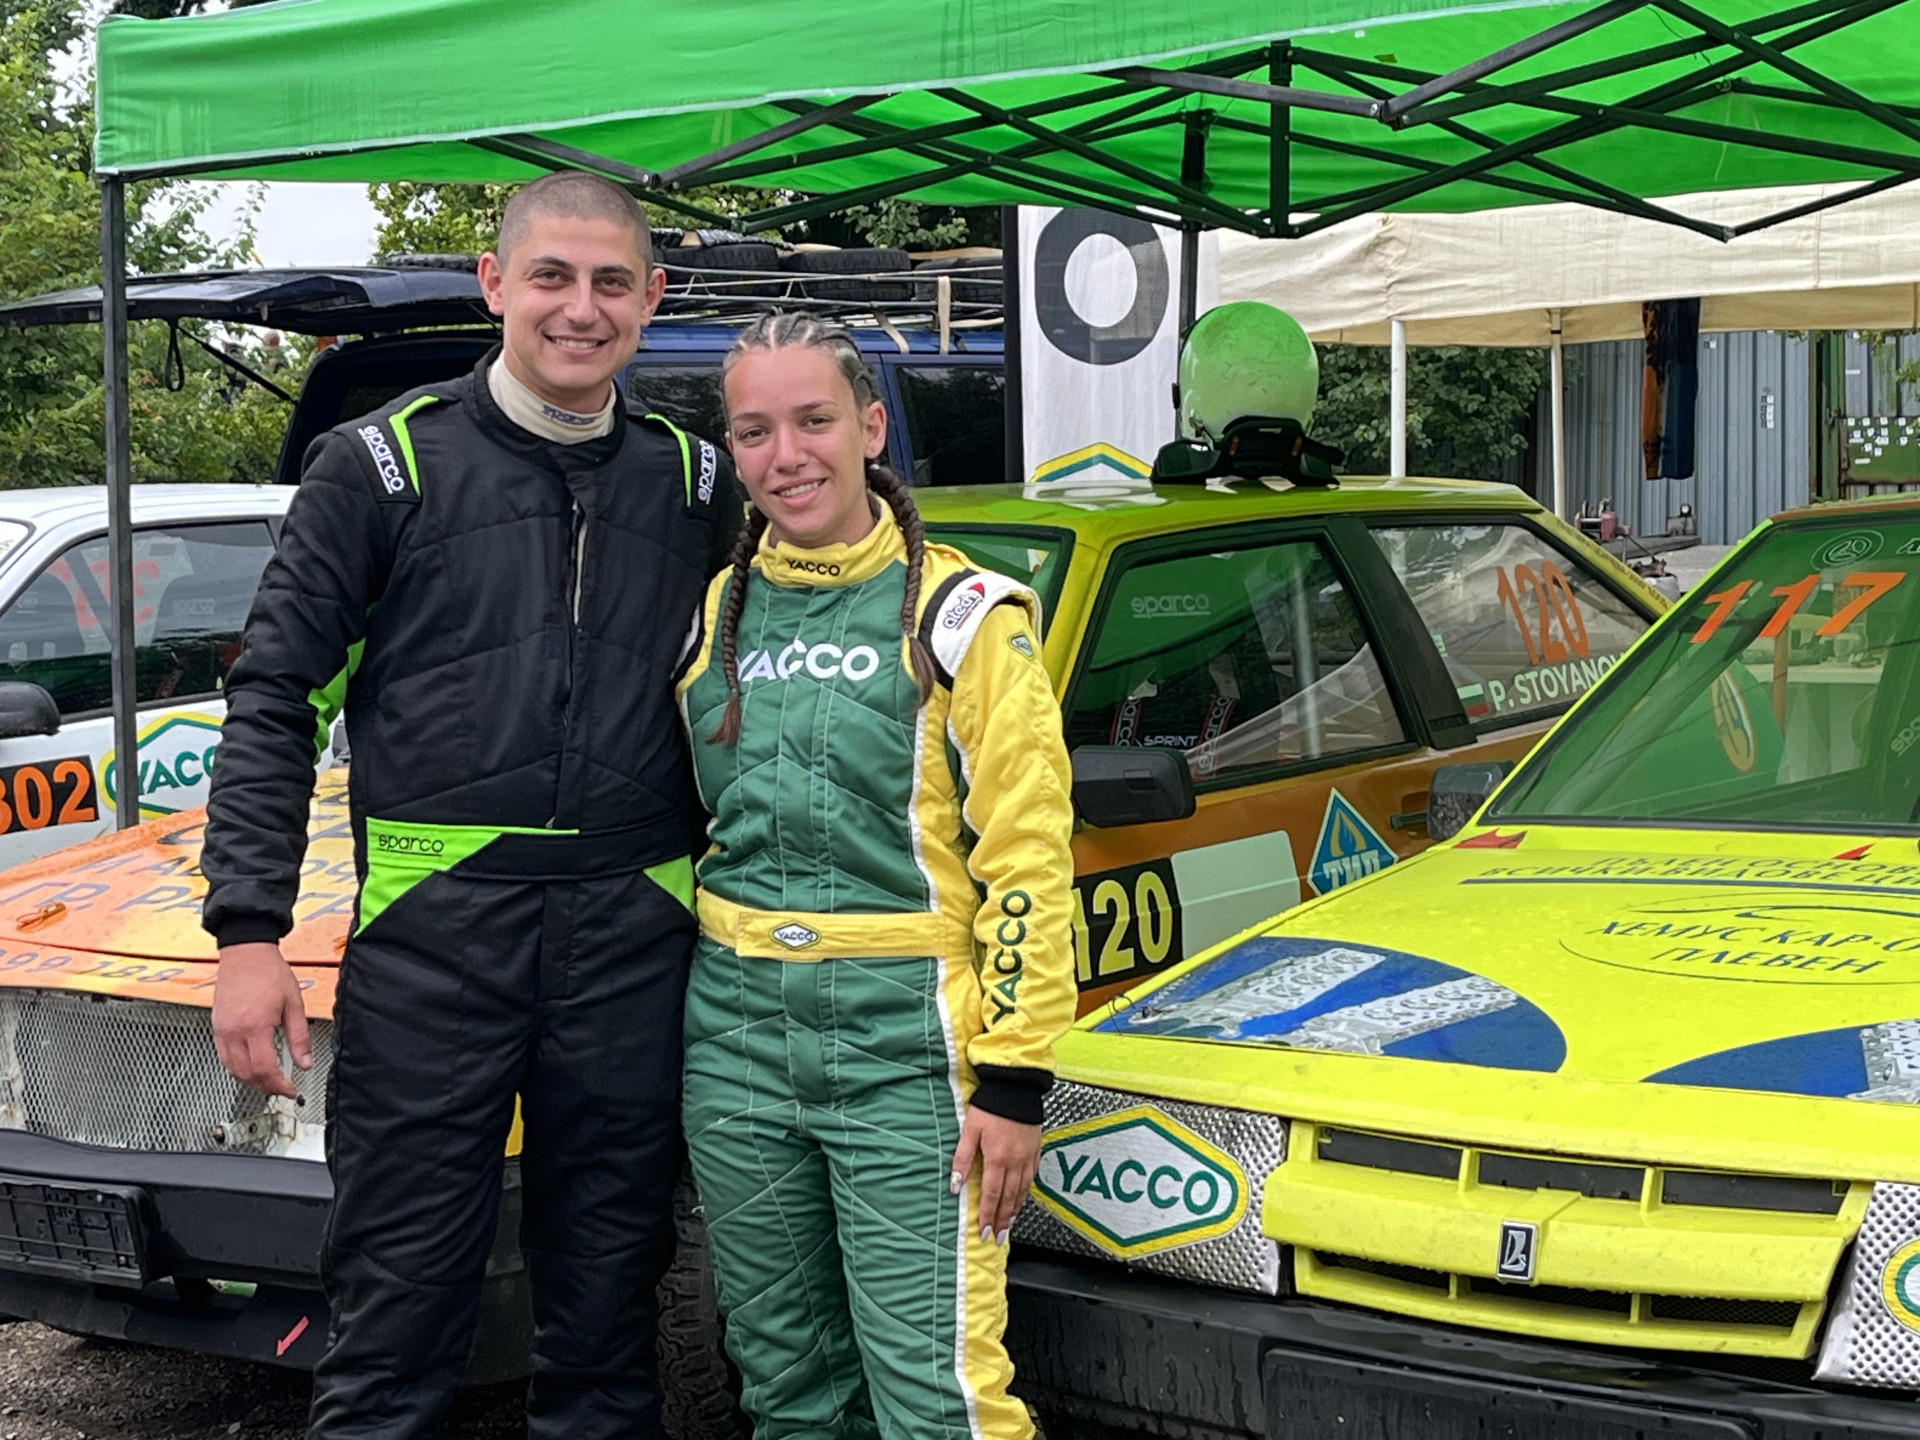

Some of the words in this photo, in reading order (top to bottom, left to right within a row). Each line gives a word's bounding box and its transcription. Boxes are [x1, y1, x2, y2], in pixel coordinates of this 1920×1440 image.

[358, 425, 405, 494] sparco
[786, 557, 841, 577] YACCO
[1131, 594, 1210, 619] sparco
[1496, 559, 1588, 666] 120
[1689, 571, 1906, 644] 117
[1489, 680, 1515, 711] P.
[1143, 735, 1198, 747] SPRINT
[378, 834, 444, 856] sparco
[775, 928, 814, 943] YACCO
[1072, 870, 1173, 982] 120
[991, 889, 1031, 1025] YACCO
[1649, 946, 1888, 974] ПЛЕВЕН
[1055, 1151, 1220, 1216] YACCO
